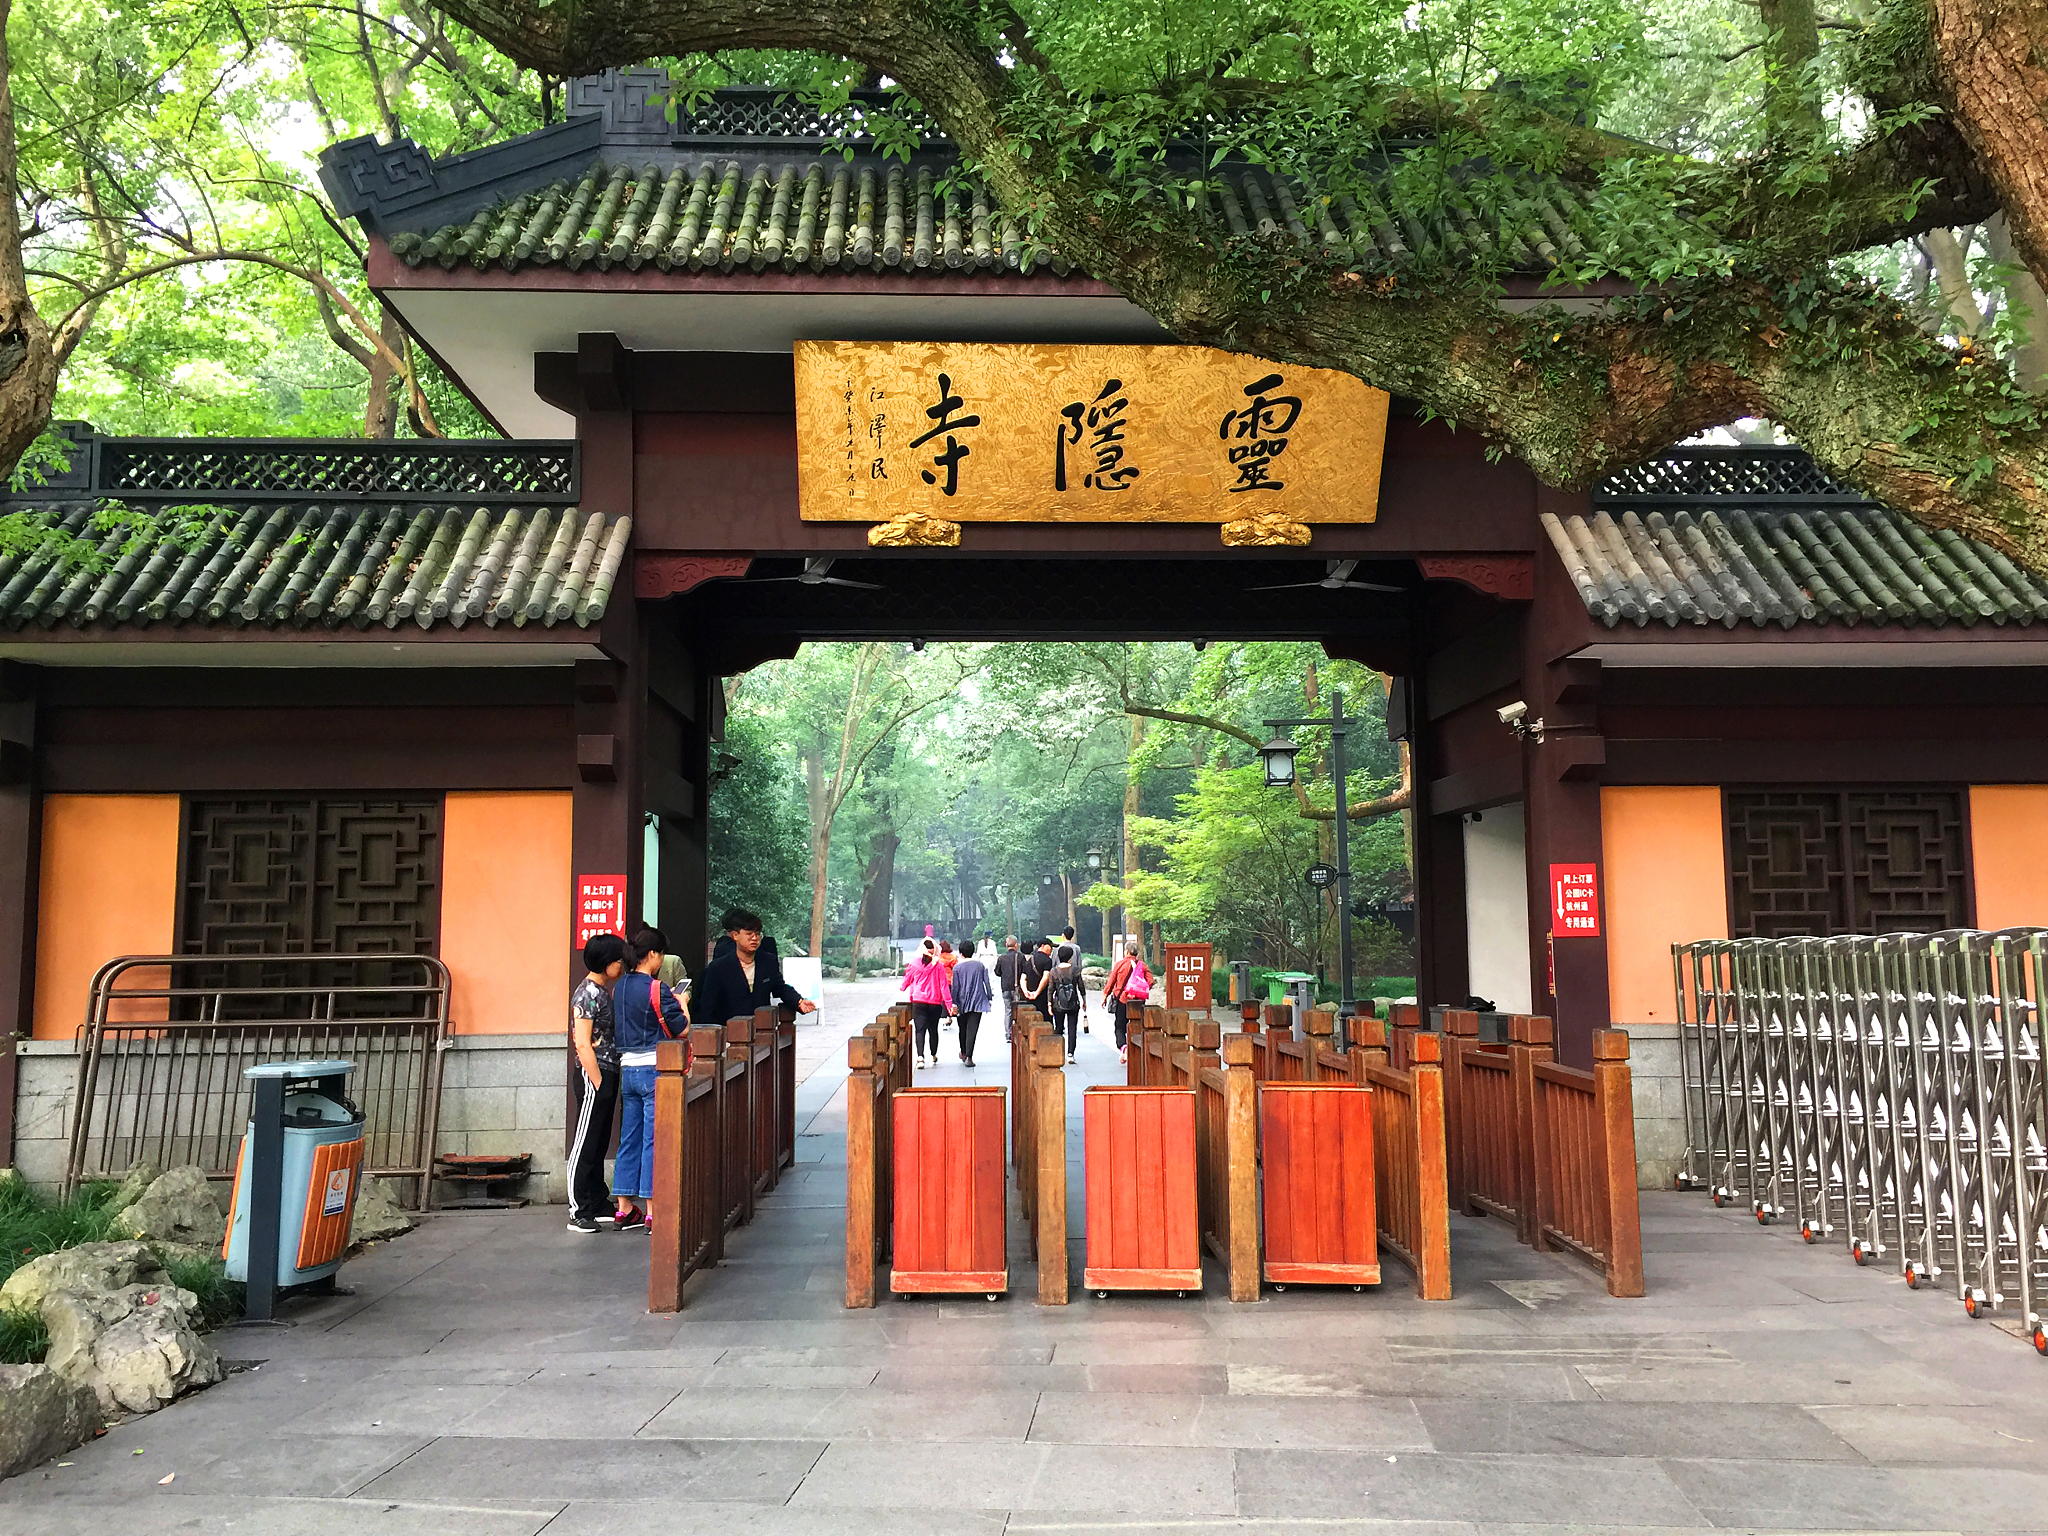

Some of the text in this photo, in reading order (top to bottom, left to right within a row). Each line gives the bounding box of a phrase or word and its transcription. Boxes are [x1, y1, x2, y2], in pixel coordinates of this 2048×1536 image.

[1563, 874, 1593, 884] 网上订票
[583, 885, 614, 896] 网上订票
[1565, 901, 1589, 911] 杭州通
[583, 913, 607, 923] 杭州通
[1565, 916, 1595, 929] 专用通道
[1174, 954, 1204, 972] 出口
[1178, 974, 1200, 983] EXIT
